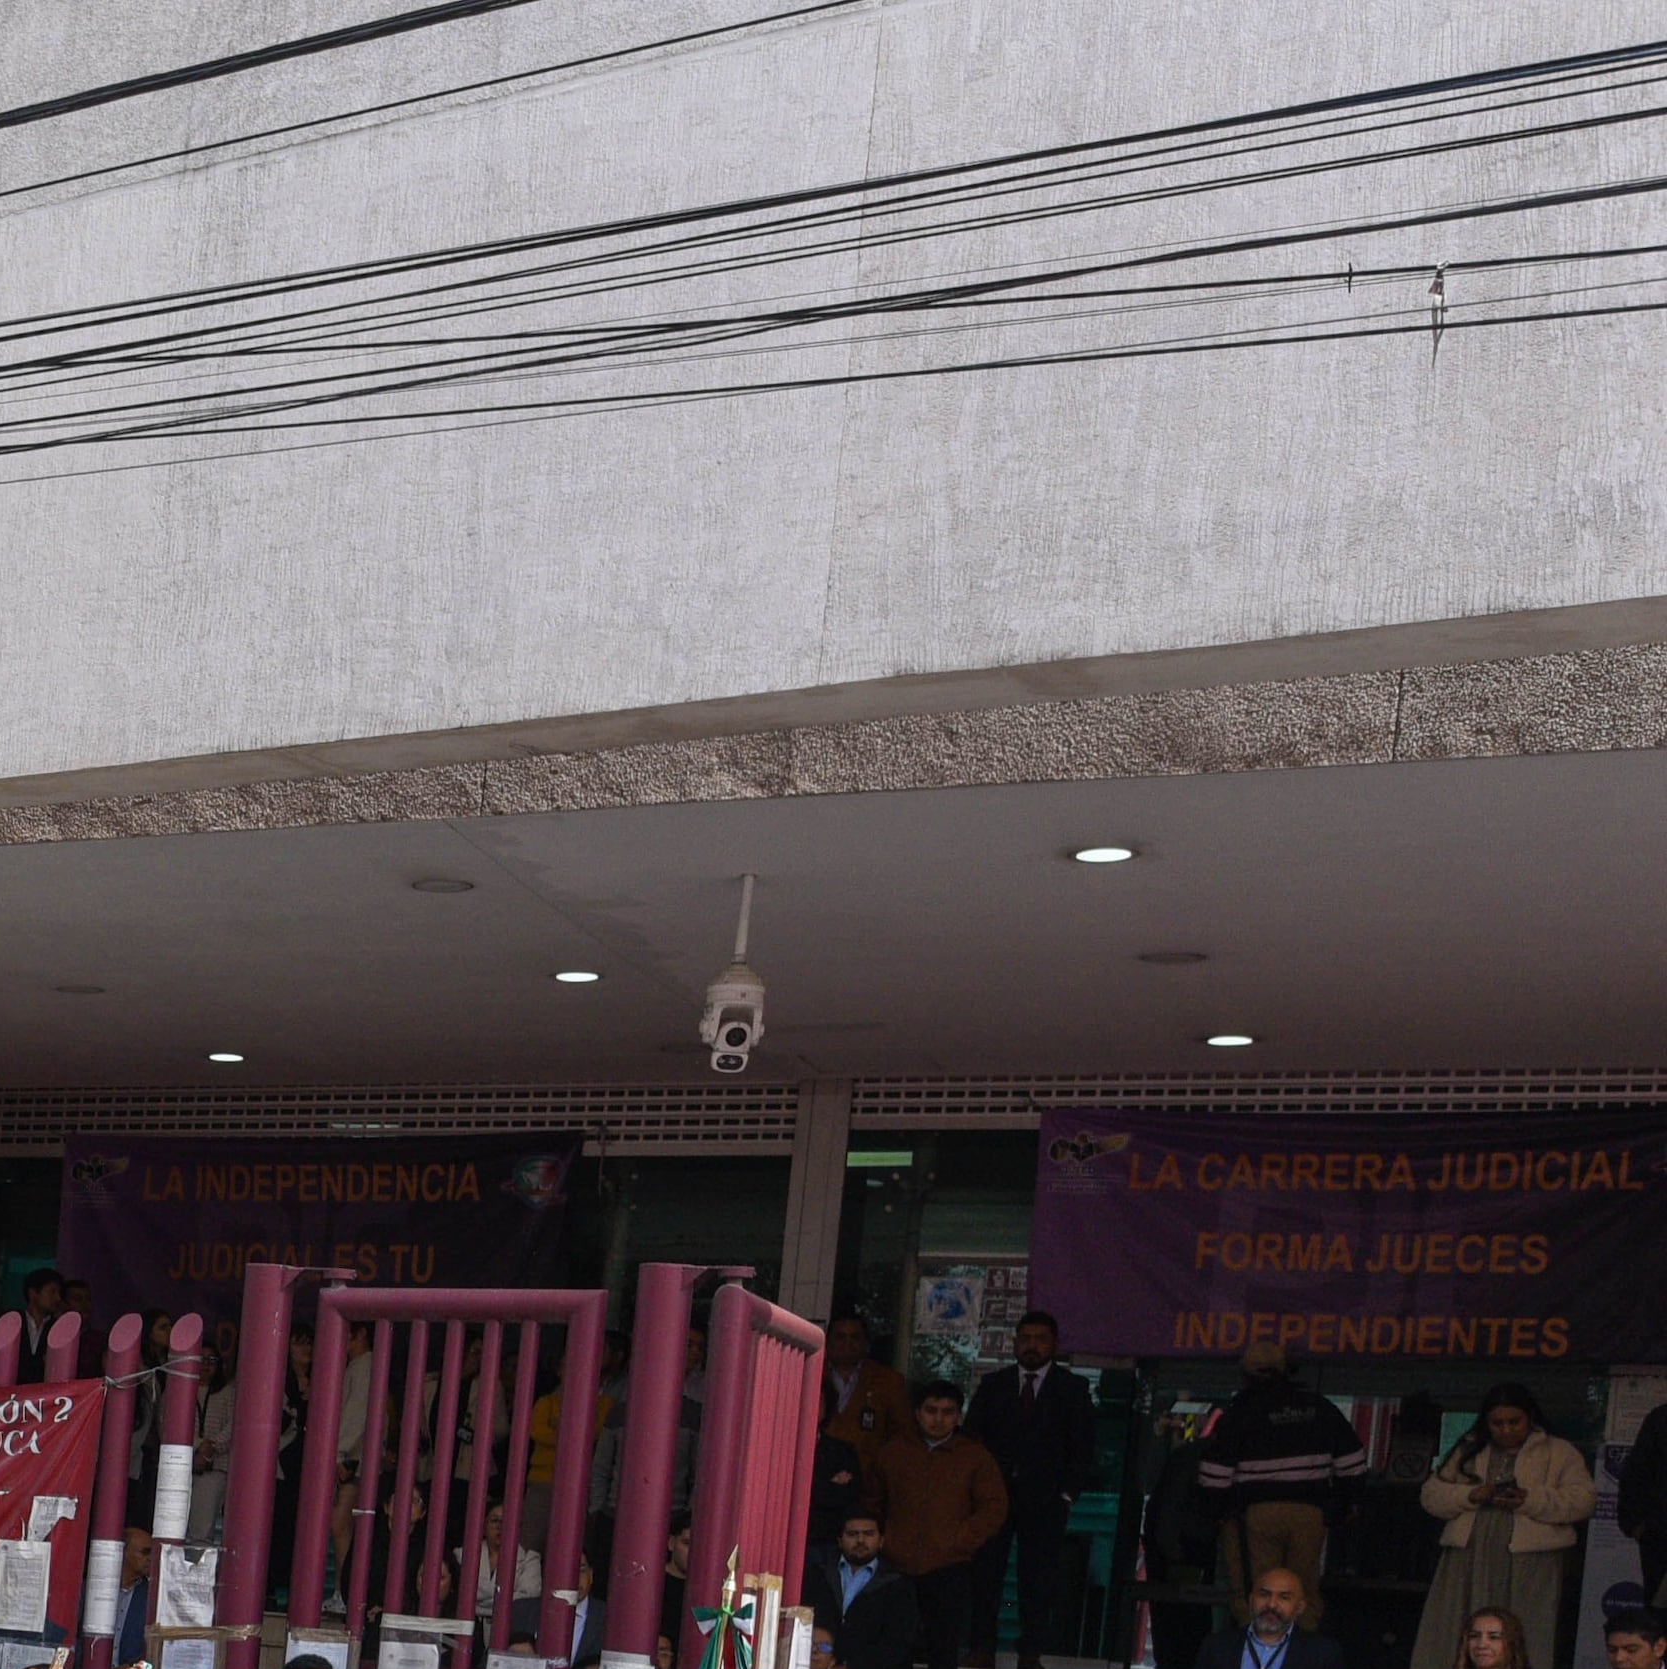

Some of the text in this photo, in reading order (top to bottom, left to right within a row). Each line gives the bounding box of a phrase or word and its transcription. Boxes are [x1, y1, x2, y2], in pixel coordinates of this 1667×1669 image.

[142, 1165, 185, 1201] LA
[195, 1161, 481, 1203] INDEPENDENCIA
[1128, 1150, 1644, 1192] LA CARRERA JUDICIAL
[334, 1242, 379, 1283] ES
[389, 1241, 437, 1285] TU
[1196, 1232, 1550, 1274] FORMA JUECES
[1174, 1312, 1572, 1359] INDEPENDIENTES
[54, 1396, 73, 1422] 2
